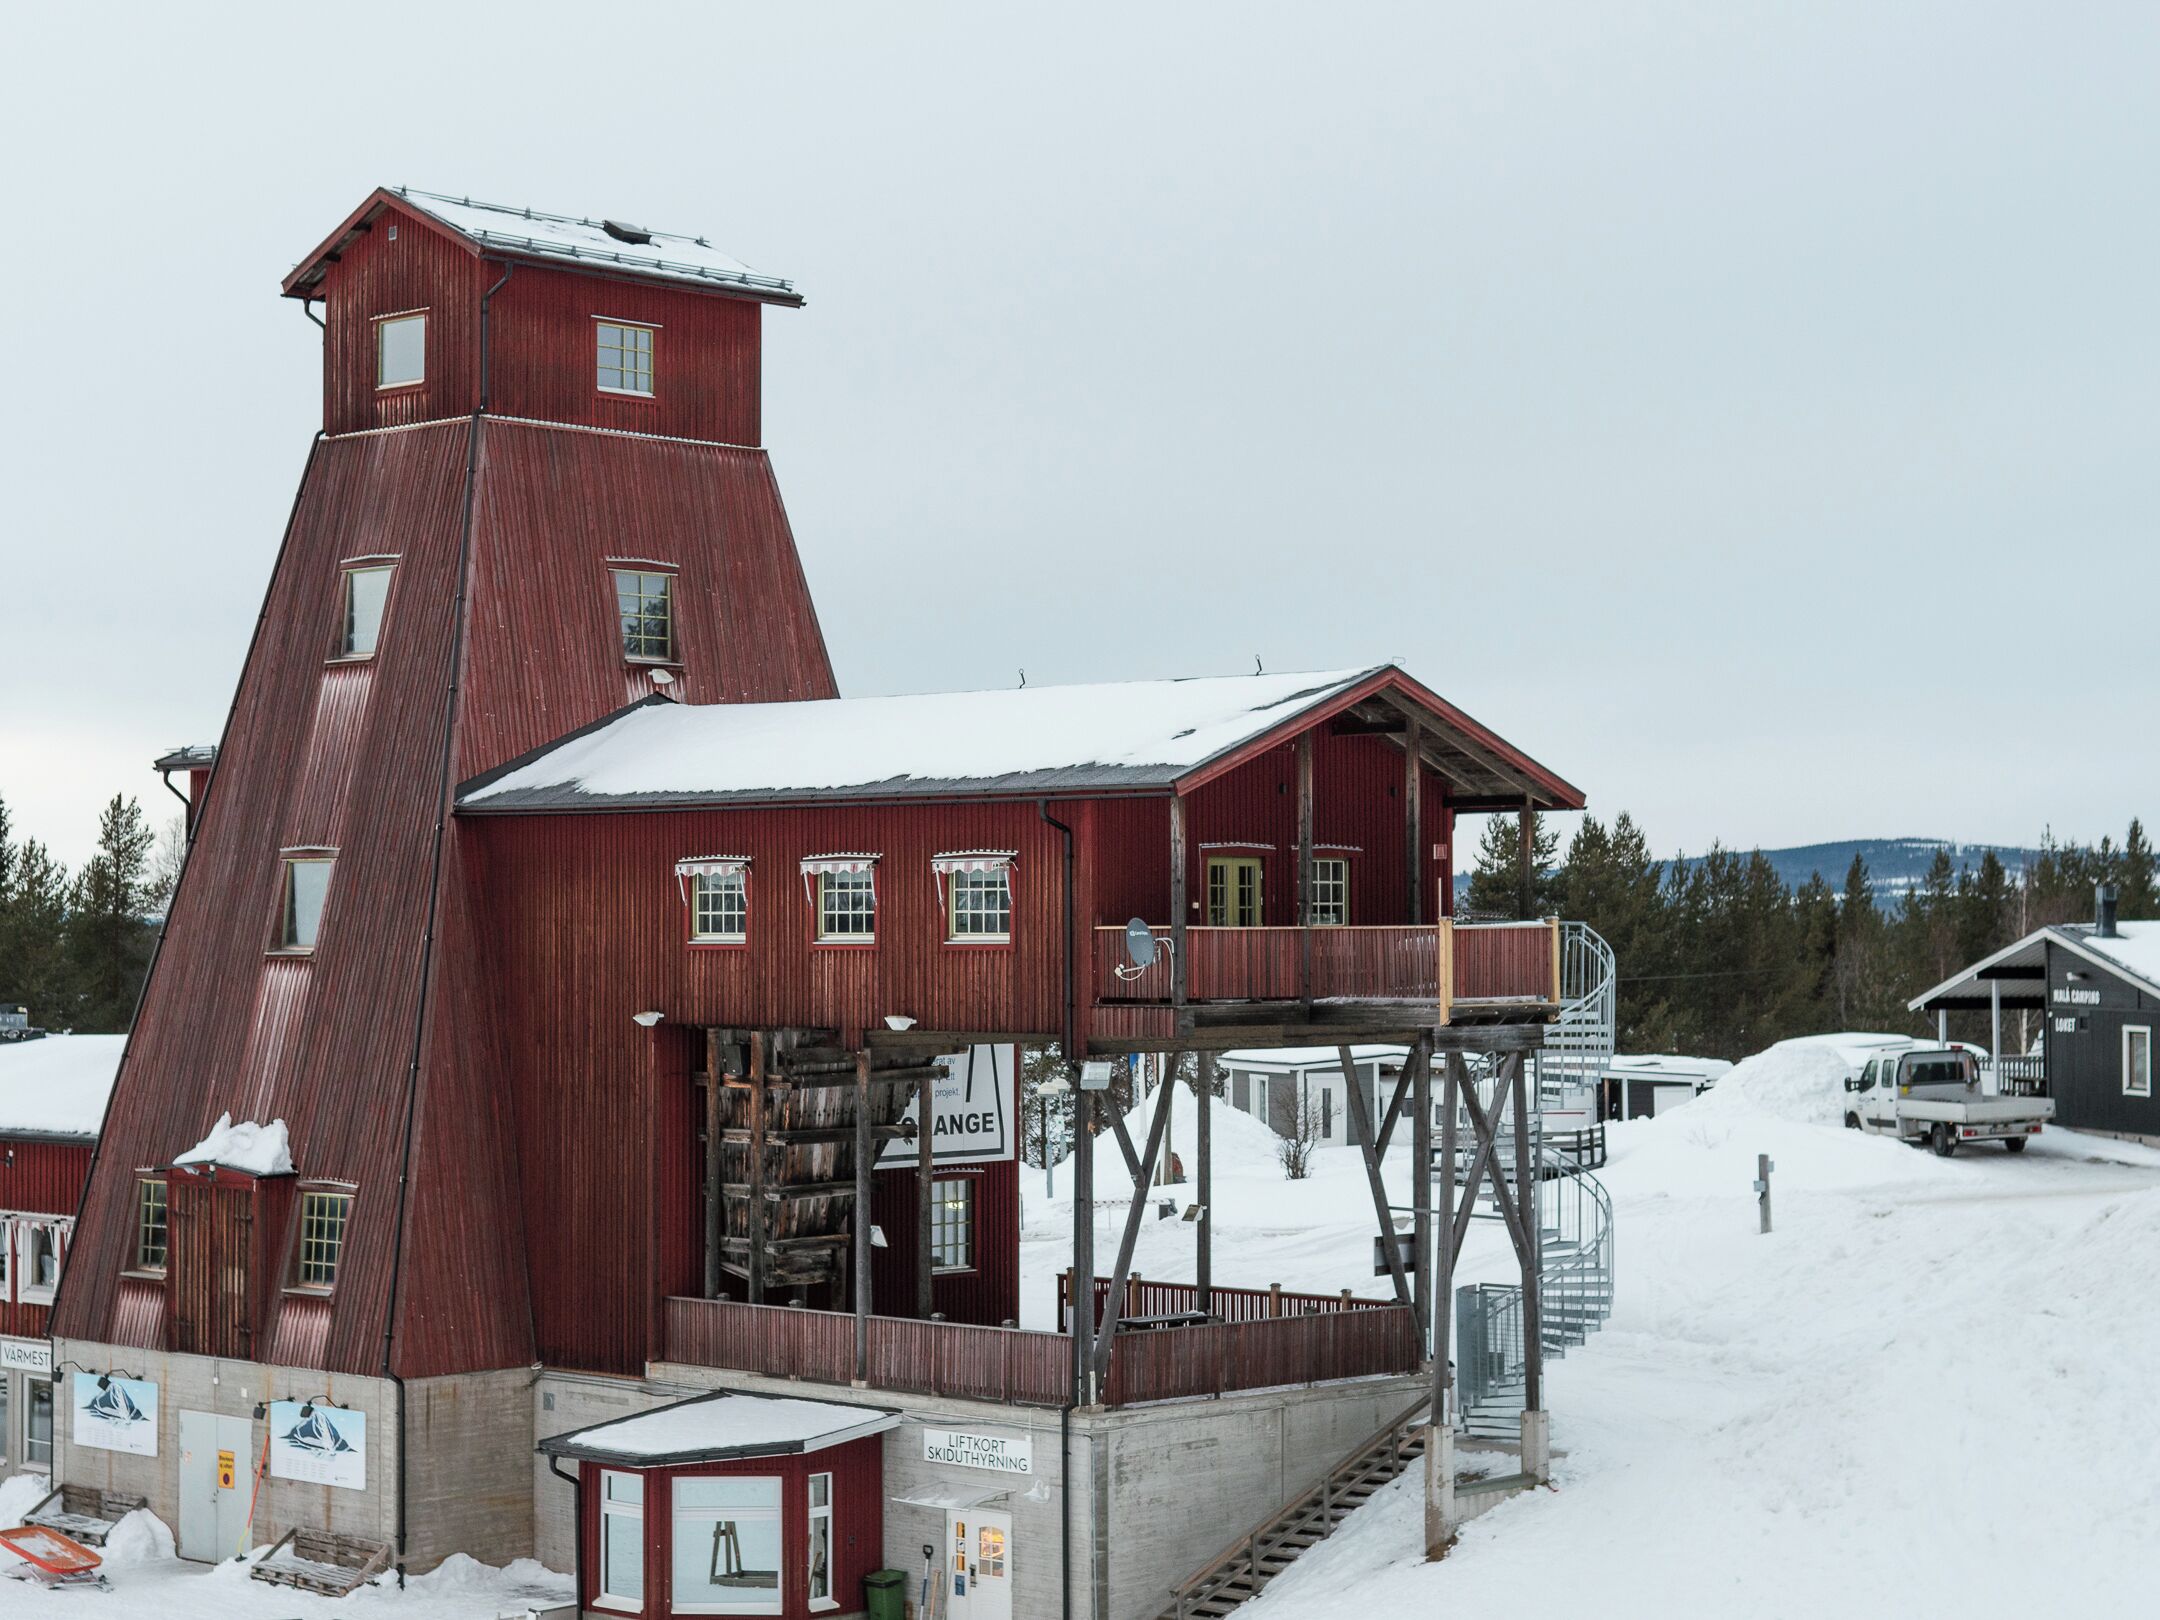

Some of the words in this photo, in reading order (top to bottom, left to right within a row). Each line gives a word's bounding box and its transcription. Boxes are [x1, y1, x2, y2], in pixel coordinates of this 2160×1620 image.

[901, 1112, 995, 1138] ANGE
[948, 1434, 1006, 1454] LIFTKORT
[928, 1446, 1028, 1472] SKIDUTHYRNING
